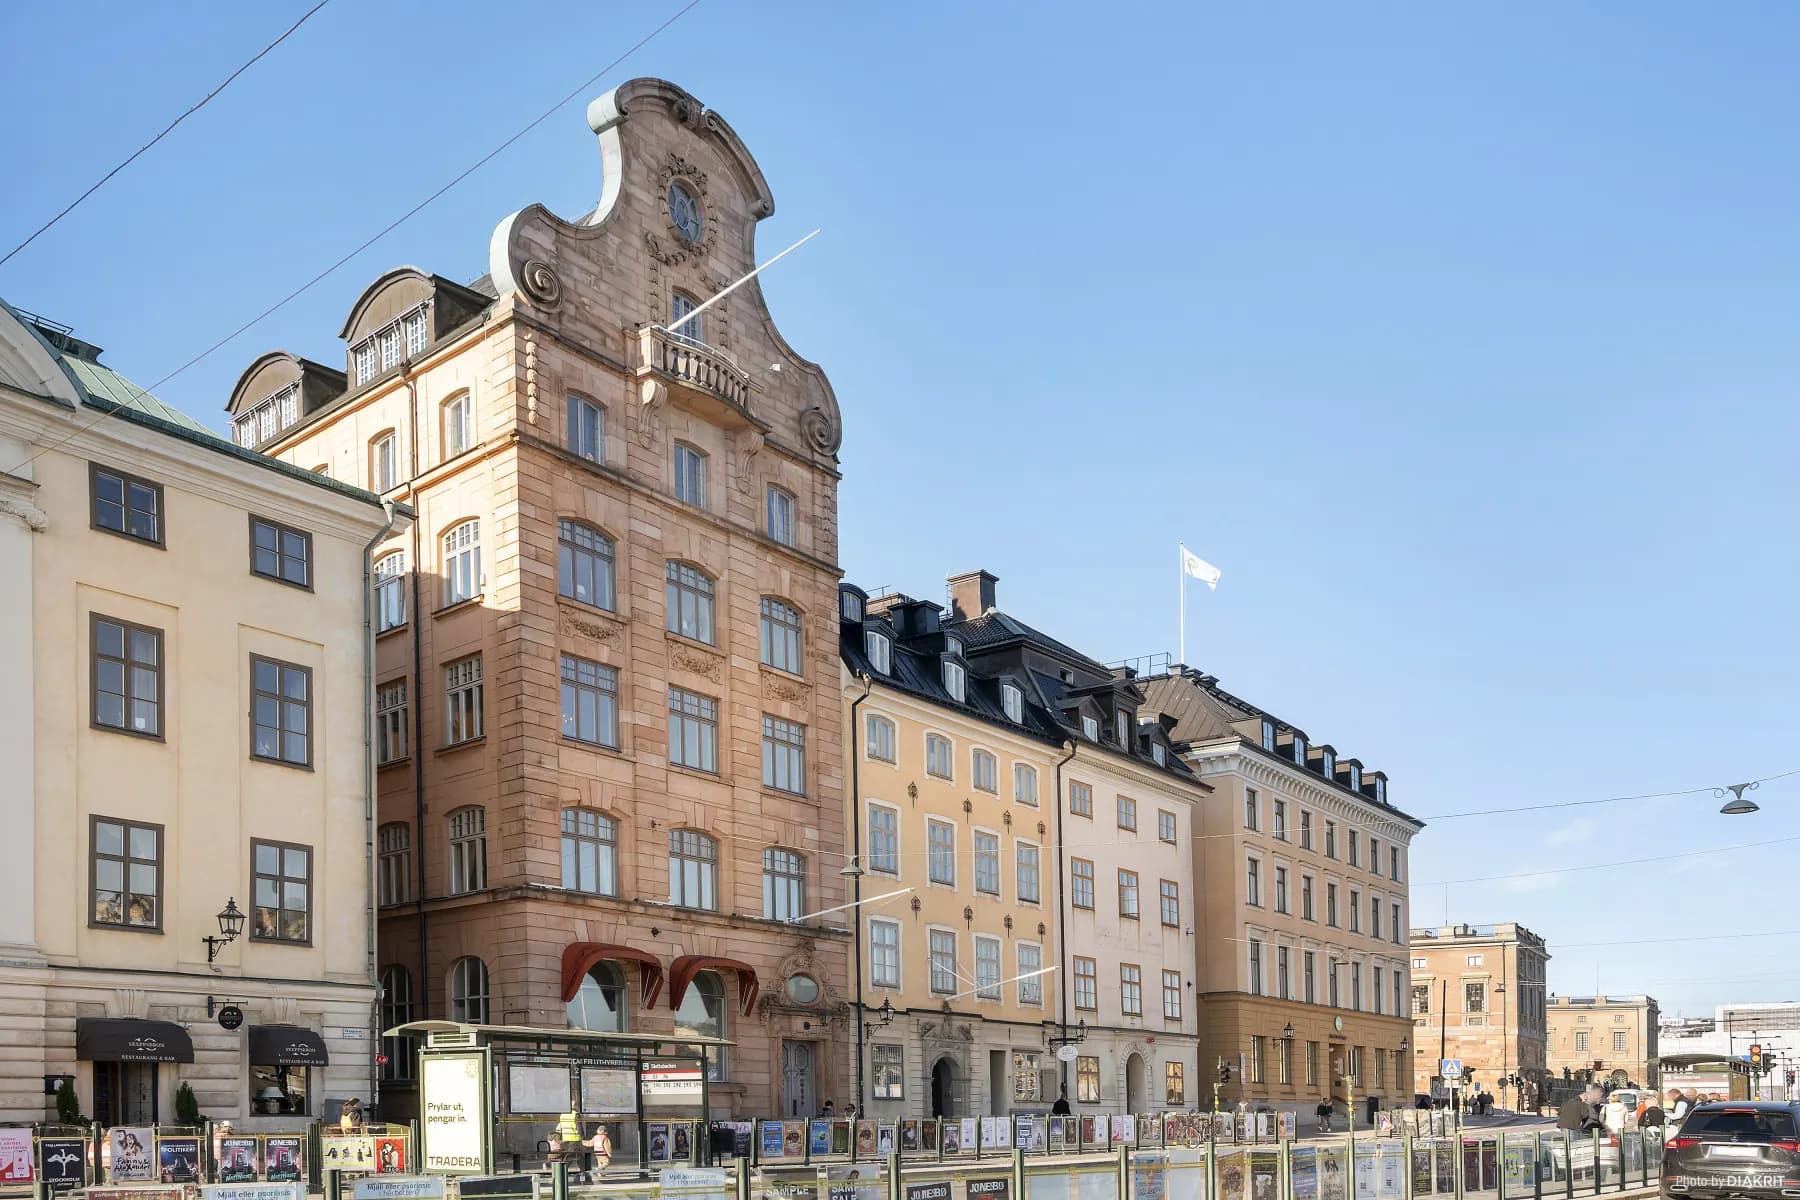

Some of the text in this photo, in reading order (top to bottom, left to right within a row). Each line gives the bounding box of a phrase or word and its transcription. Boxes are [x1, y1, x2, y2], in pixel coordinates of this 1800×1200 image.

[428, 1102, 464, 1112] Prylar ut,
[427, 1115, 456, 1124] pengar
[429, 1156, 480, 1167] TRADERA
[765, 1184, 809, 1197] SAMPLE
[831, 1181, 872, 1193] SAMPLE
[258, 1190, 291, 1198] psoriasis
